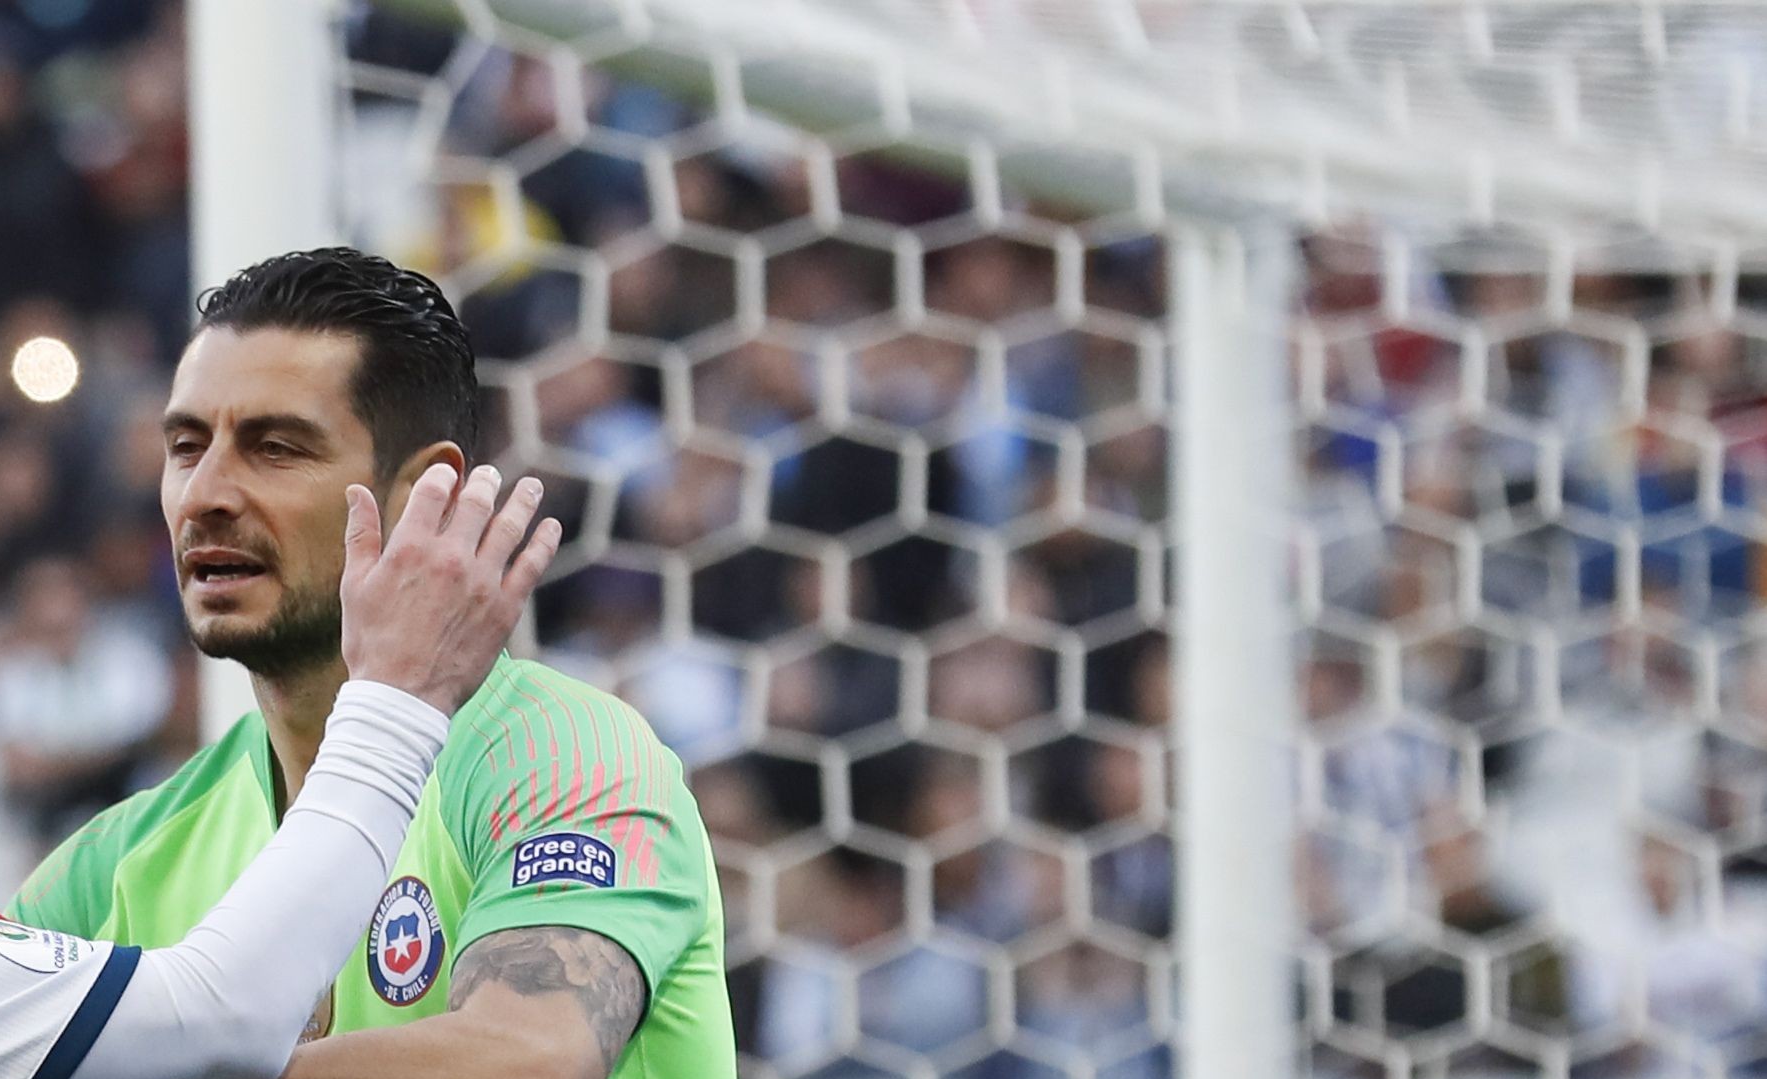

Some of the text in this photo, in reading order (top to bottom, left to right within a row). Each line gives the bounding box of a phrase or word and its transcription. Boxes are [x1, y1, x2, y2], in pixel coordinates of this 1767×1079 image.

[518, 840, 611, 868] Cree en
[516, 857, 606, 885] grande
[402, 976, 428, 1002] CHILE
